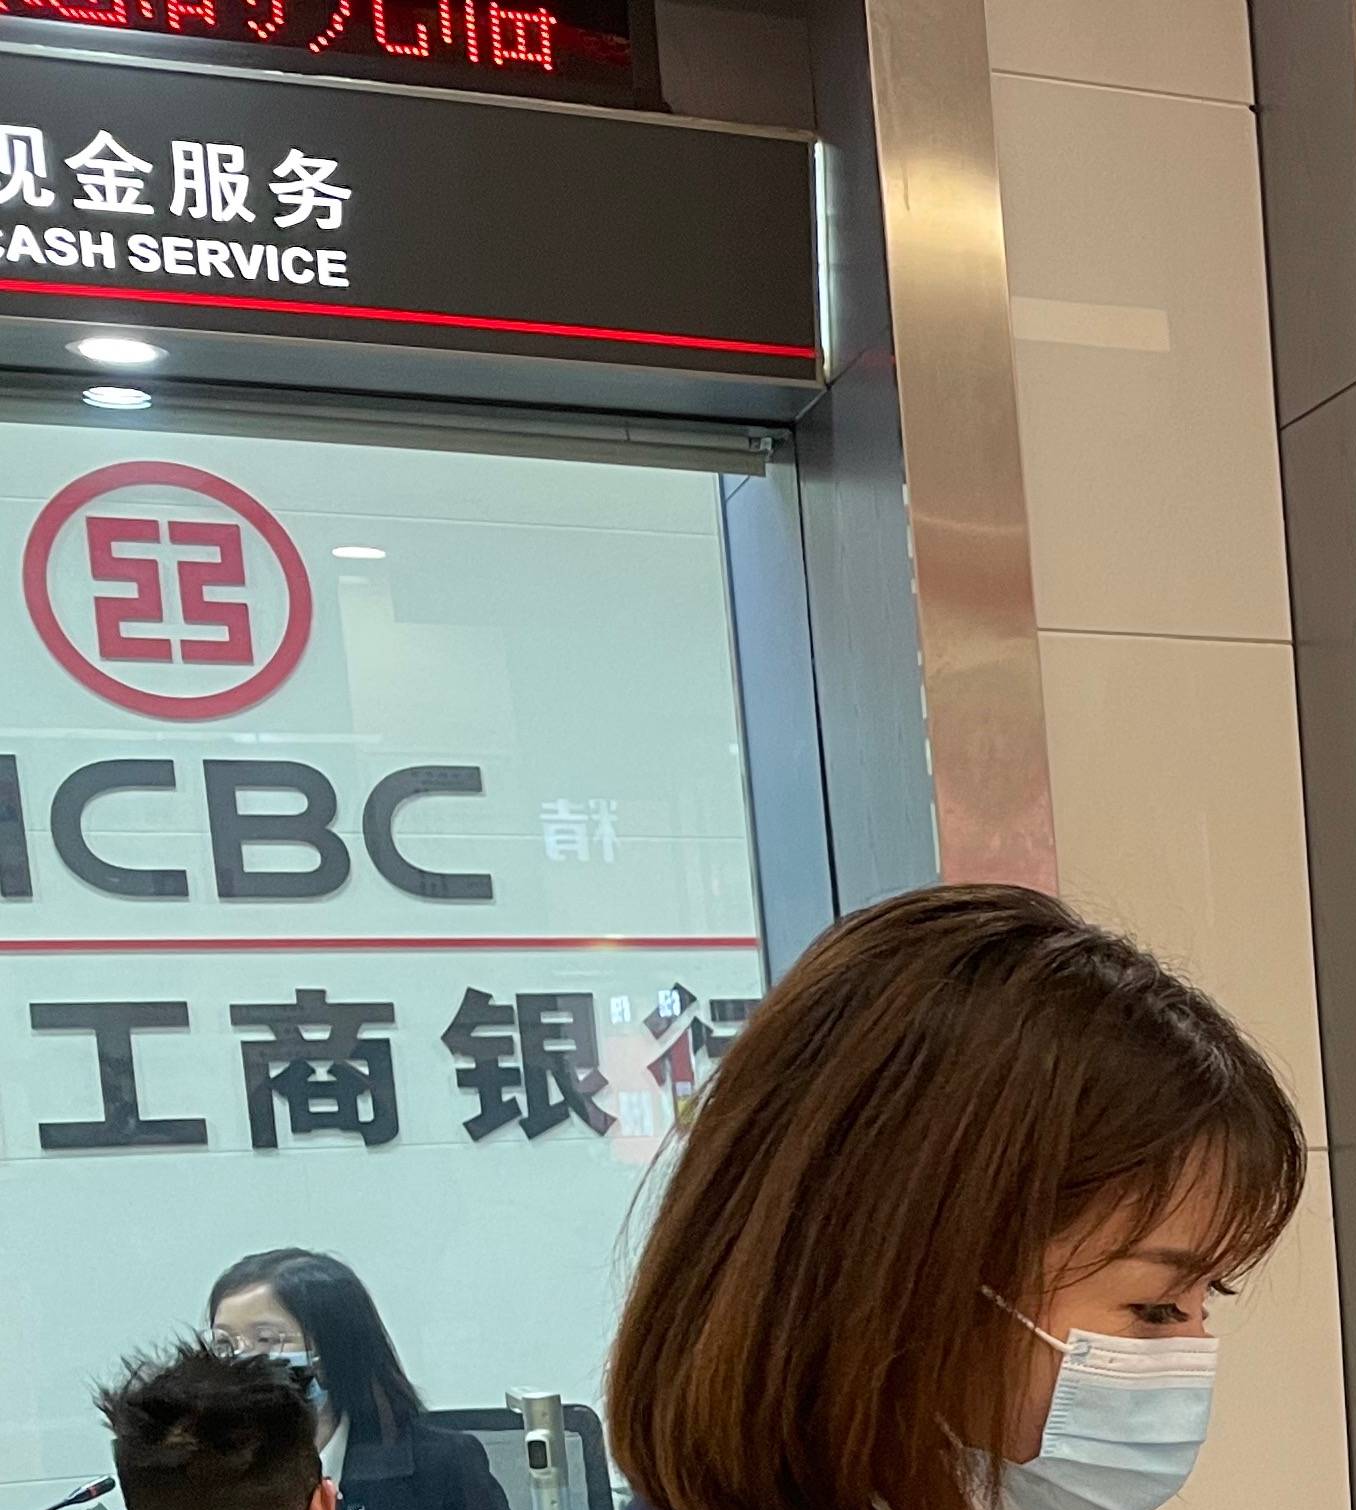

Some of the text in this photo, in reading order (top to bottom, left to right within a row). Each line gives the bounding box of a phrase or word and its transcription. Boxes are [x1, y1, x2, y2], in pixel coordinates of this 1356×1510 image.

[0, 123, 352, 230] 现金服务
[0, 224, 350, 288] ASH SERVICE
[0, 753, 494, 901] ICBC
